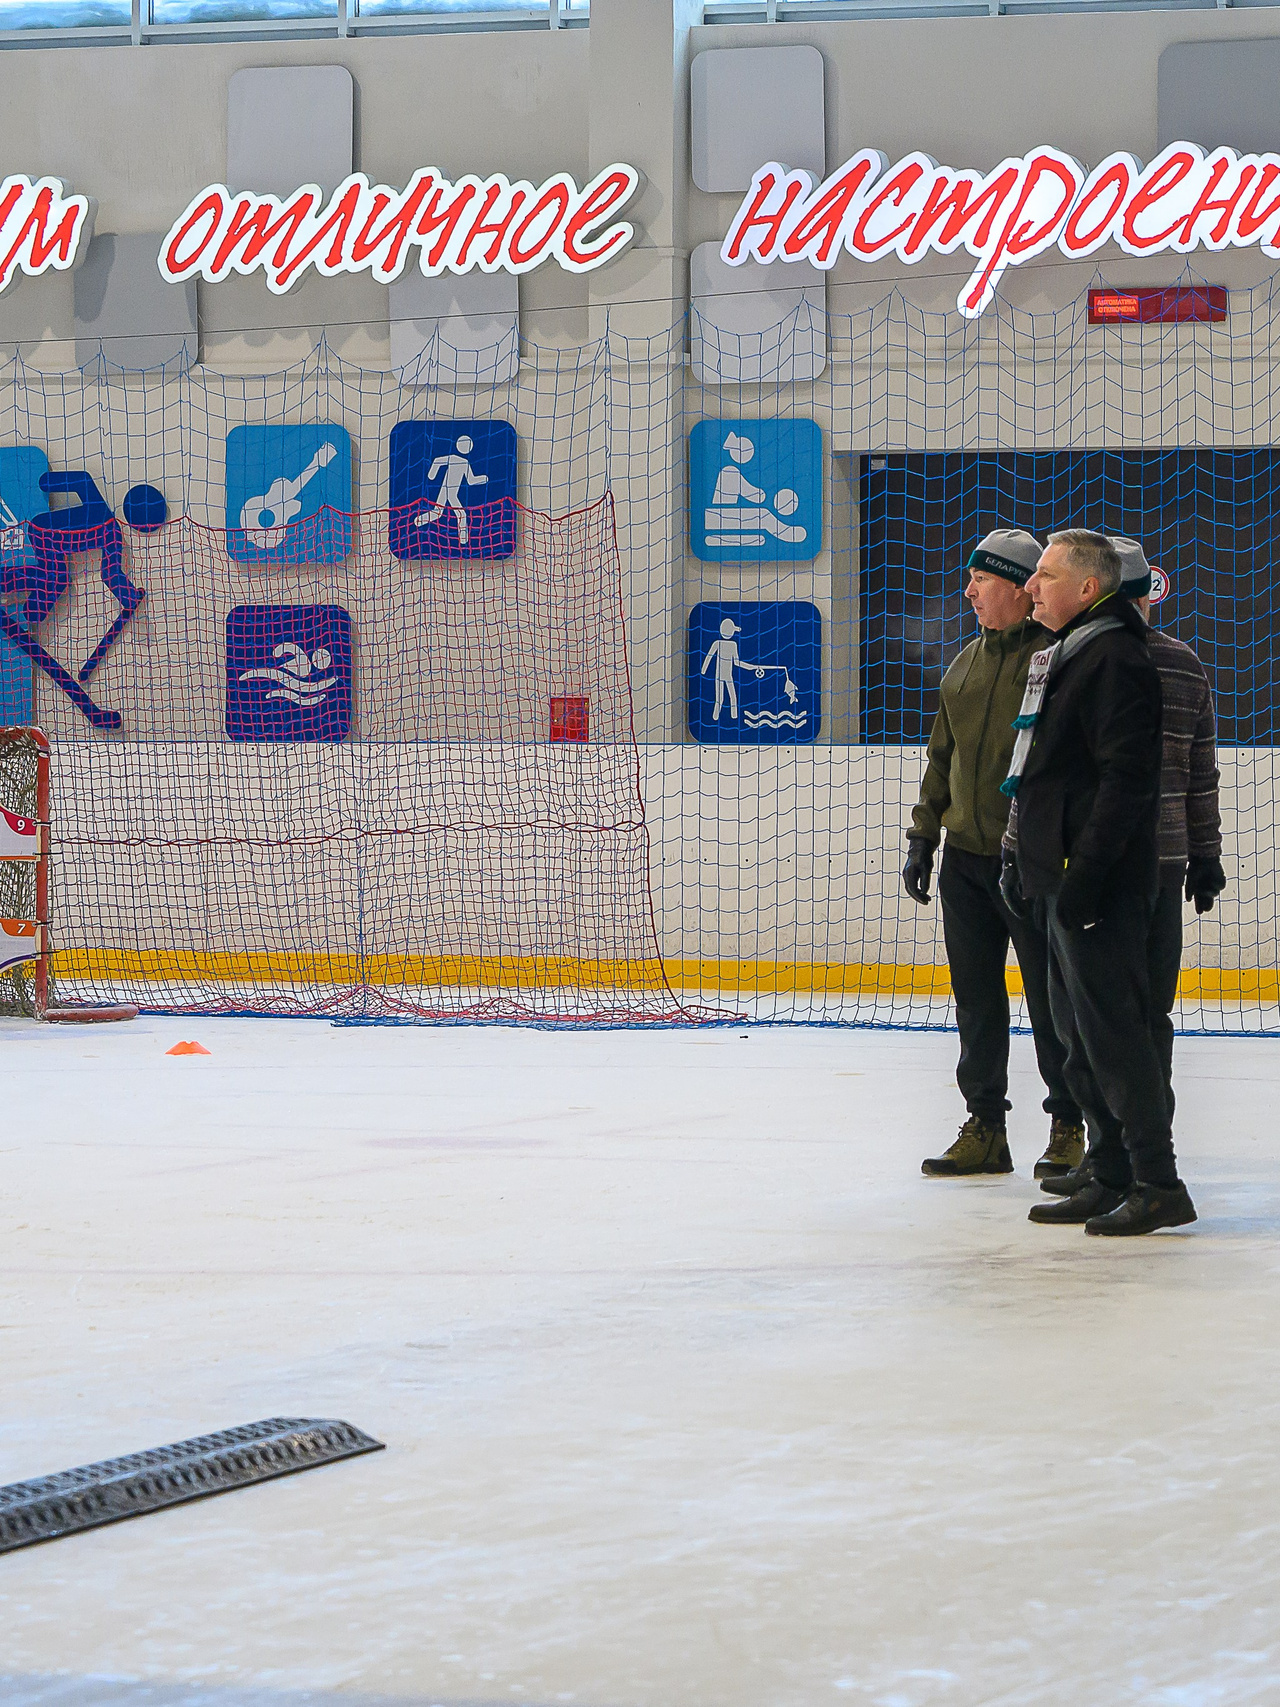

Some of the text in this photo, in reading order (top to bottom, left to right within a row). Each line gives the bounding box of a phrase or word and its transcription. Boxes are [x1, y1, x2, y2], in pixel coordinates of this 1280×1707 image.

[165, 172, 629, 287] отличное
[17, 819, 26, 832] 9
[17, 923, 26, 934] 7
